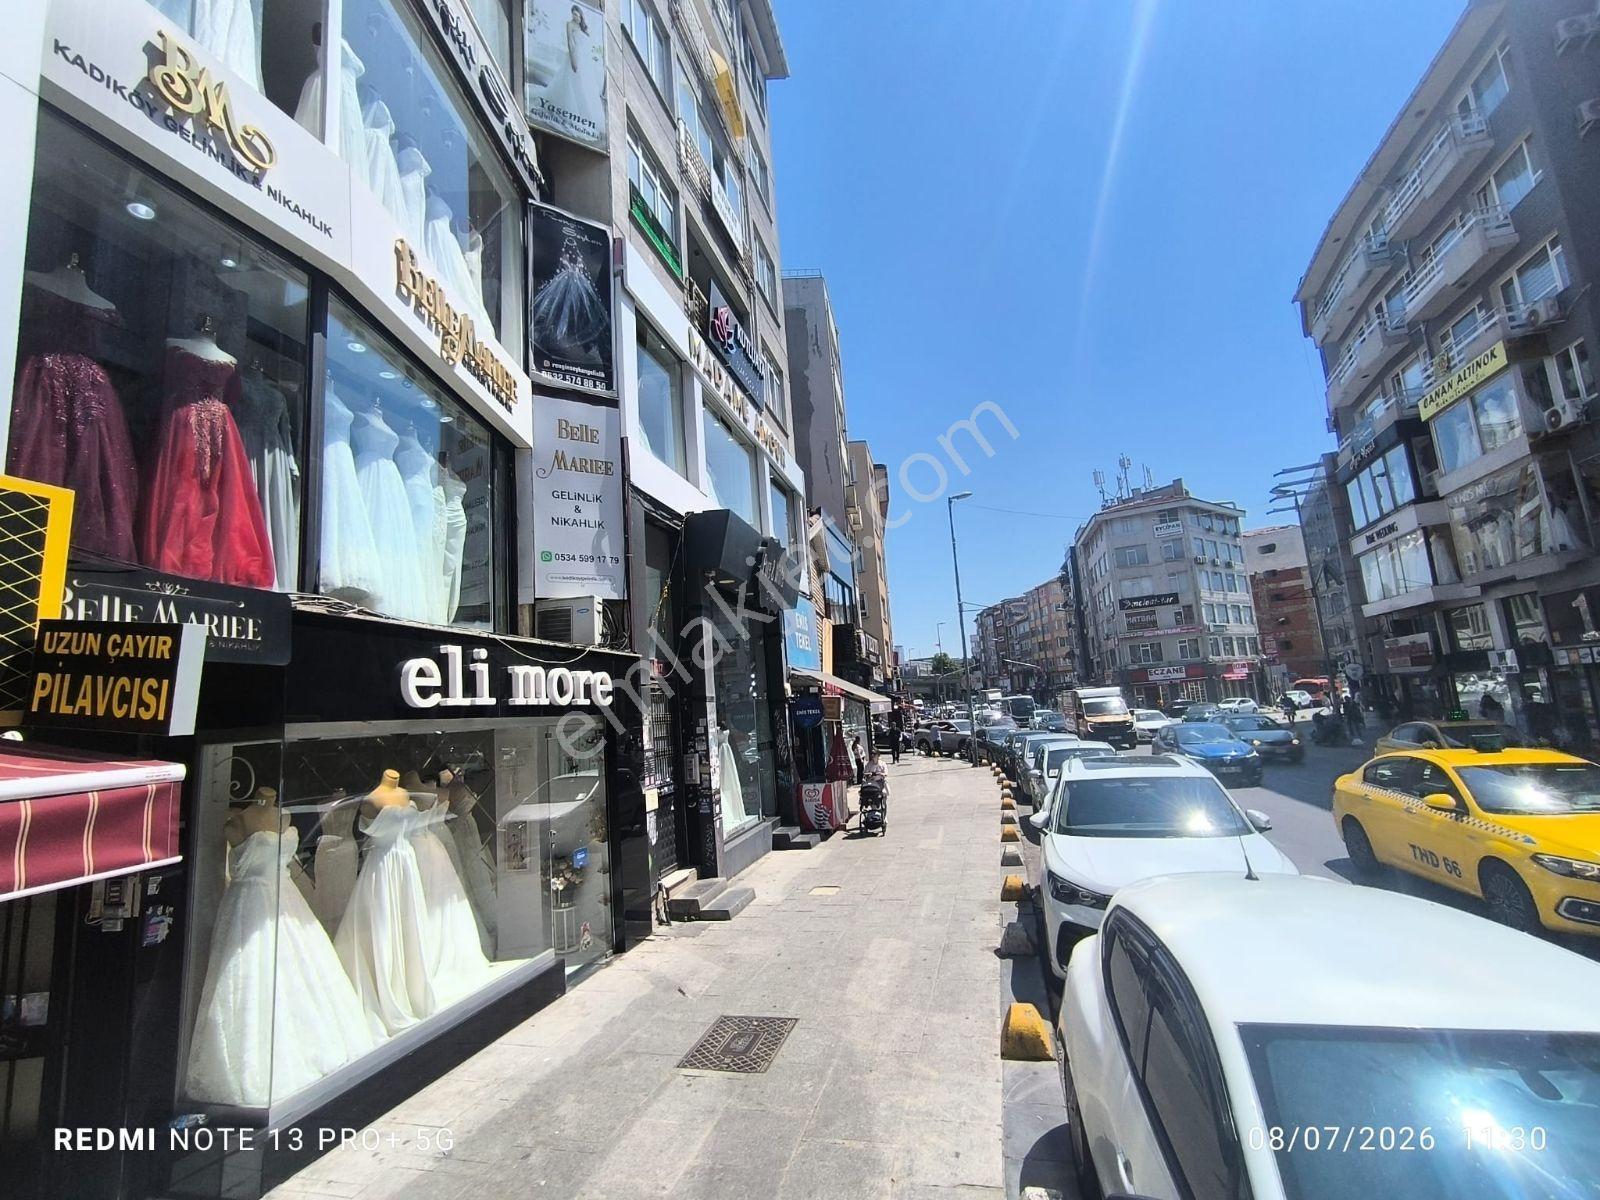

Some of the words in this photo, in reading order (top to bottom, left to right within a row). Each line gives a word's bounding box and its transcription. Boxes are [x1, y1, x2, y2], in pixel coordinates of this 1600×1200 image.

[538, 97, 596, 129] Yasemen
[54, 38, 157, 119] KADIKÖY
[266, 184, 334, 239] NİKAHLIK
[566, 375, 581, 386] 574
[583, 379, 594, 388] 88
[1456, 347, 1498, 386] ALTINOK
[551, 490, 603, 504] GELİNLİK
[574, 505, 582, 514] &
[551, 516, 605, 530] NİKAHLIK
[554, 552, 576, 562] 0534
[579, 554, 595, 563] 599
[597, 555, 607, 564] 17
[609, 556, 620, 565] 79
[44, 631, 101, 655] UZUN
[107, 634, 172, 663] ÇAYIR
[401, 645, 496, 708] eli
[507, 664, 613, 706] more
[1148, 667, 1185, 676] ECZANE
[31, 661, 169, 721] PİLAVCISI
[1408, 843, 1440, 868] THD
[1443, 859, 1462, 878] 66
